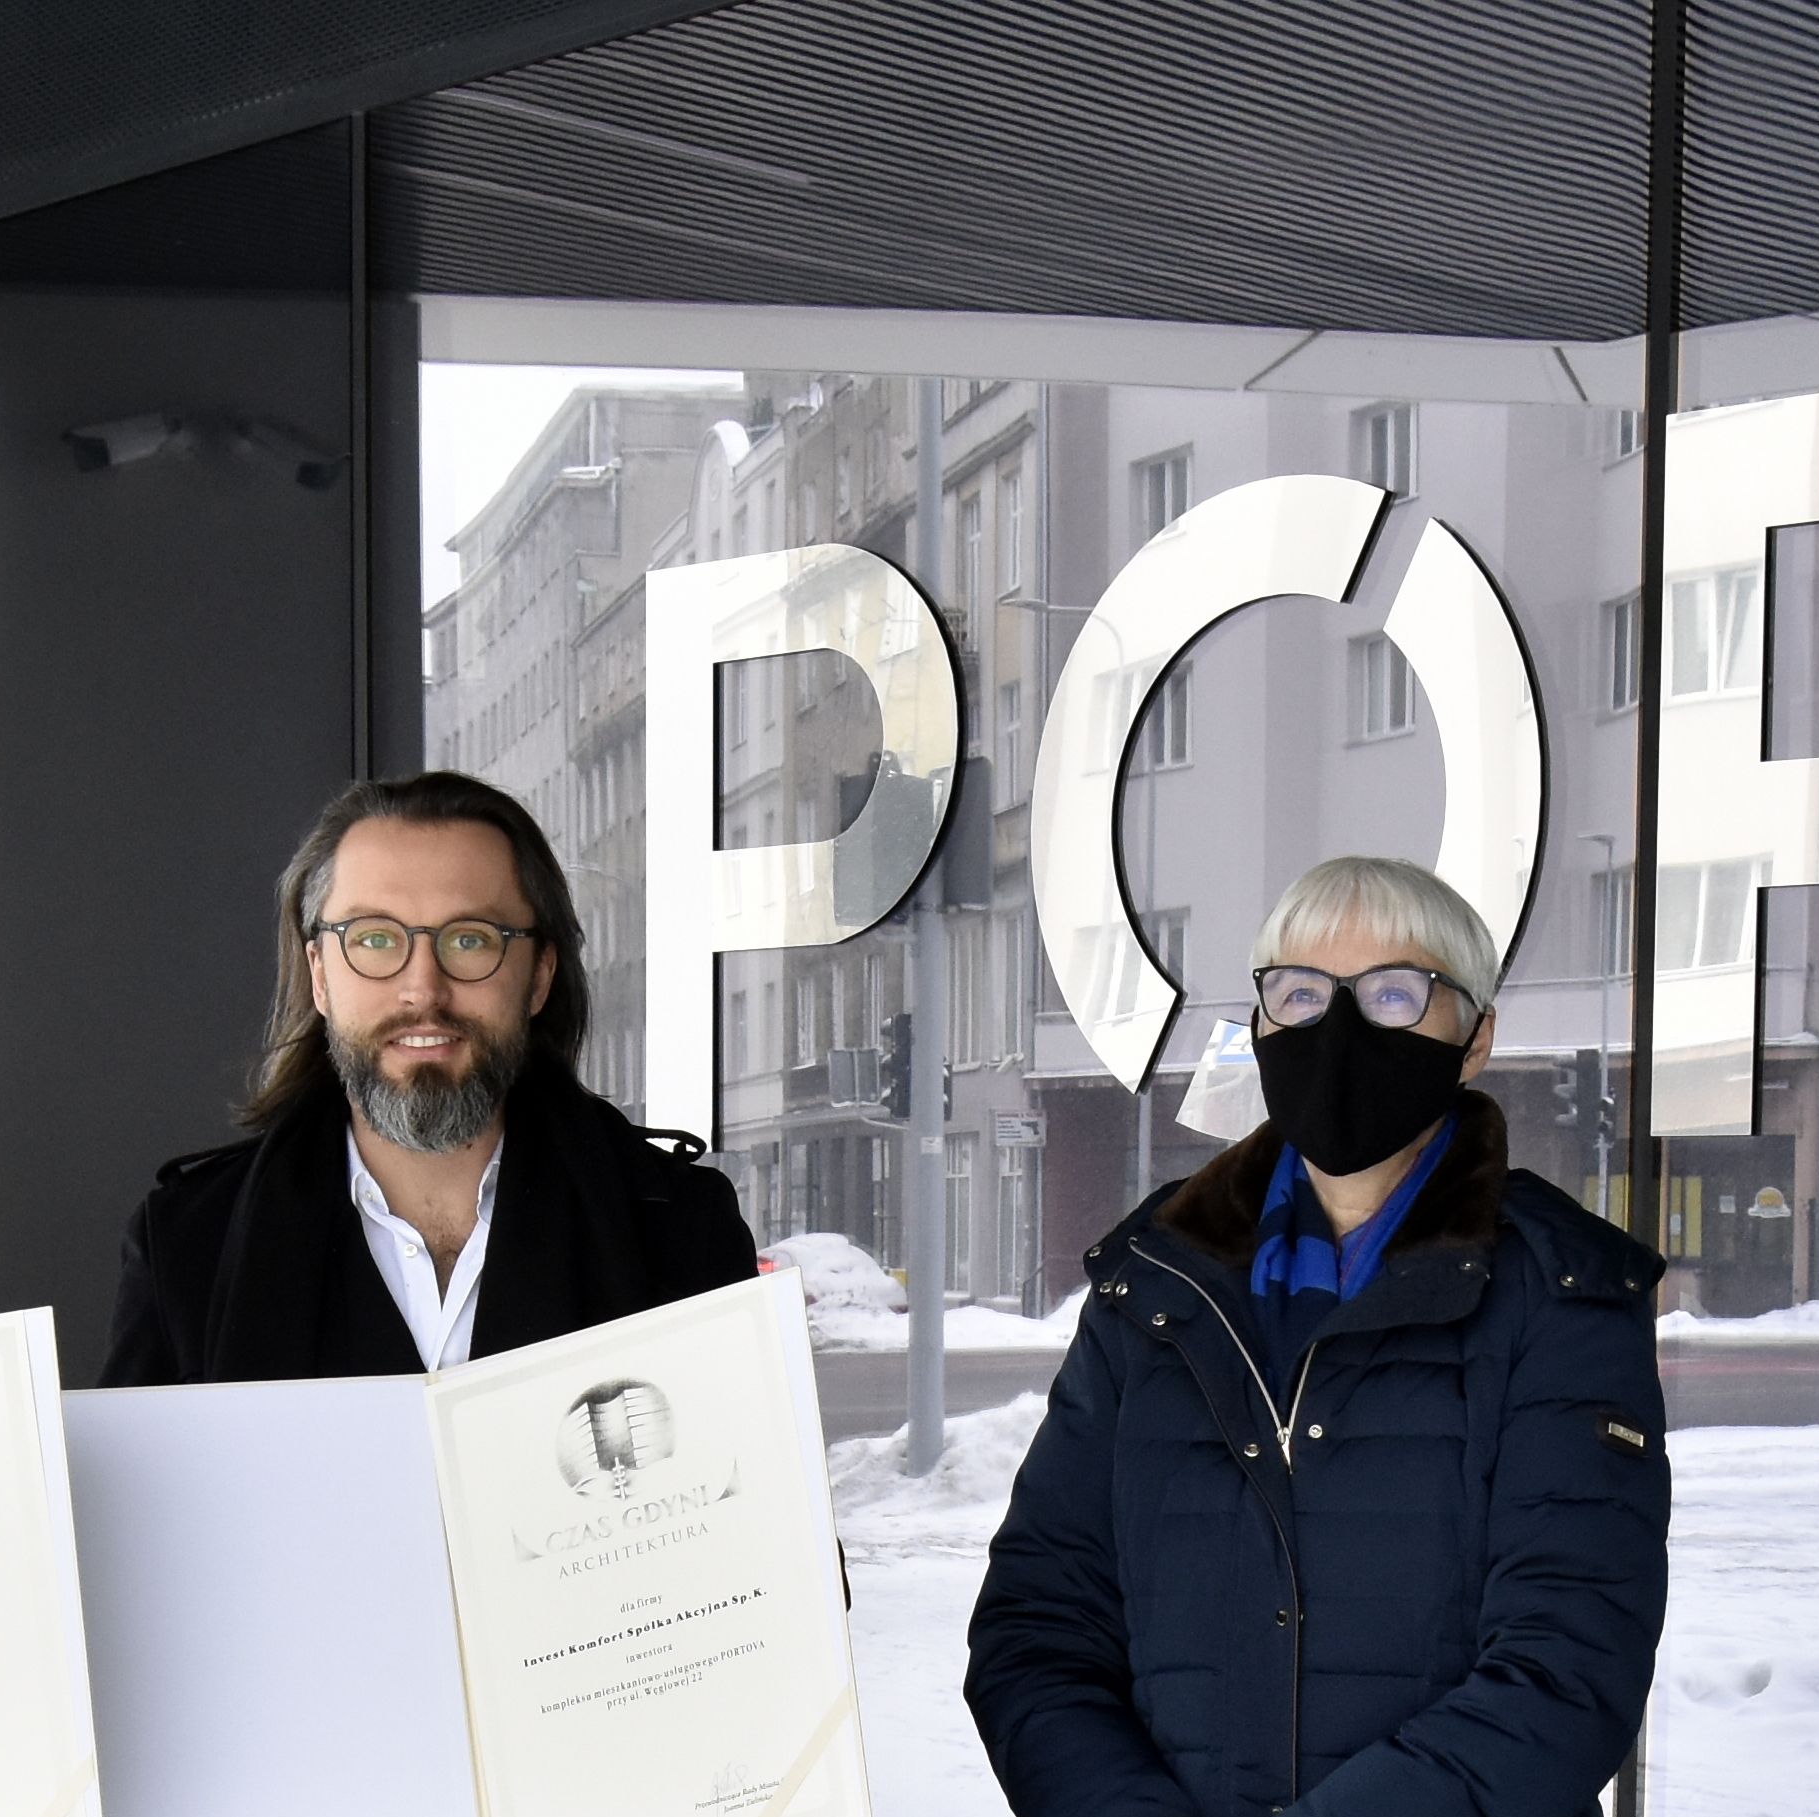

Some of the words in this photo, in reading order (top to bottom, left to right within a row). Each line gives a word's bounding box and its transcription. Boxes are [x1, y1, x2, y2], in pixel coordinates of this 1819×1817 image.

[545, 1515, 613, 1553] CZAS
[622, 1485, 709, 1529] GDYNI
[559, 1522, 709, 1579] ARCHITEKTURA
[620, 1602, 636, 1613] dla
[636, 1594, 663, 1611] firmy
[523, 1648, 566, 1668] Invest
[568, 1631, 624, 1655] Komfort
[675, 1600, 729, 1623] Akcyjna
[625, 1643, 673, 1664] inwestora
[540, 1691, 592, 1714] kompleksu
[720, 1639, 765, 1661] PORTOVA
[606, 1693, 628, 1710] przy
[629, 1690, 643, 1702] ul.
[691, 1672, 703, 1683] 22
